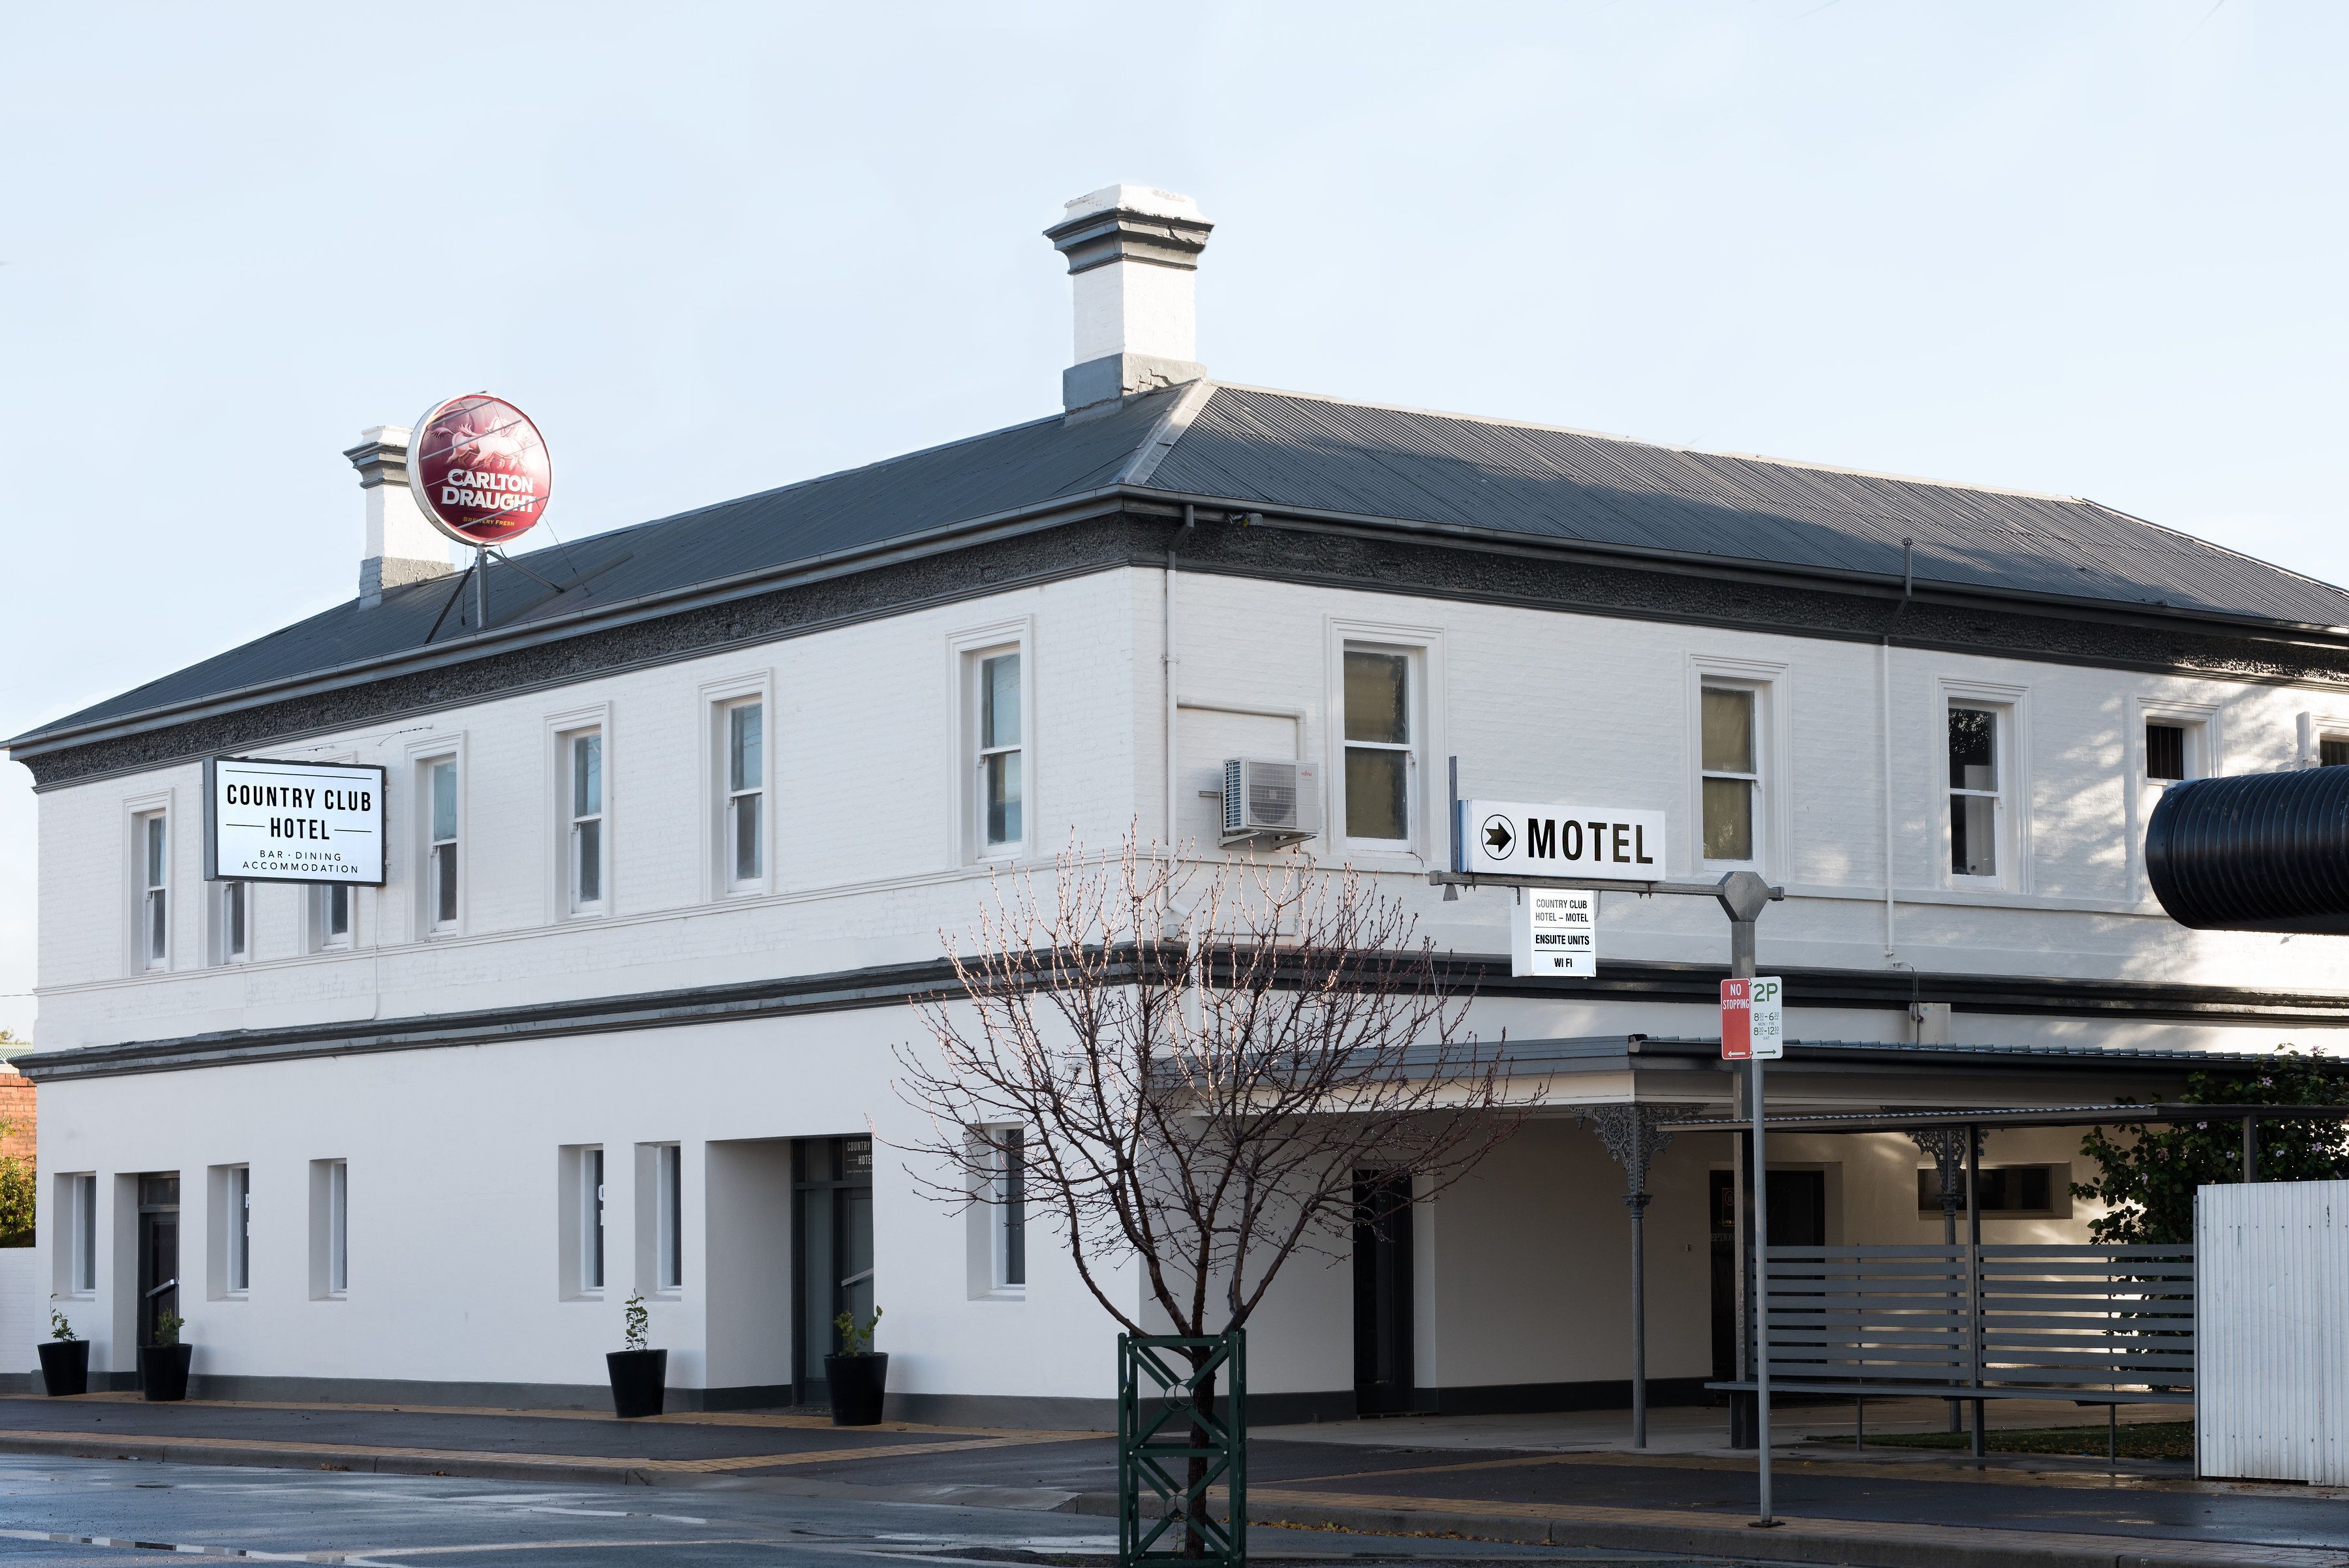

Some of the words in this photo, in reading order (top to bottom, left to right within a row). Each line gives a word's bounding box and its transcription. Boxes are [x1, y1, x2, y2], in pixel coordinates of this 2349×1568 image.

[448, 469, 534, 493] CARLTON
[441, 486, 536, 512] DRAUGHT
[227, 784, 315, 808] COUNTRY
[324, 789, 371, 812] CLUB
[270, 817, 330, 840] HOTEL
[1528, 818, 1653, 864] MOTEL
[260, 850, 283, 859] BAR
[296, 852, 341, 861] DINING
[242, 861, 358, 874] ACCOMMODATION
[1536, 899, 1567, 908] COUNTRY
[1569, 900, 1587, 909] CLUB
[1535, 912, 1557, 921] HOTEL
[1566, 913, 1589, 922] MOTEL
[1535, 934, 1566, 944] ENSUITE
[1568, 935, 1589, 945] UNITS
[1554, 958, 1563, 968] WI
[1566, 959, 1573, 968] FI
[1730, 983, 1742, 996] NO
[1754, 983, 1778, 1002] 2P
[1723, 998, 1749, 1009] STOPPING
[847, 1141, 870, 1151] COUNTRY
[858, 1155, 872, 1165] HOTE
